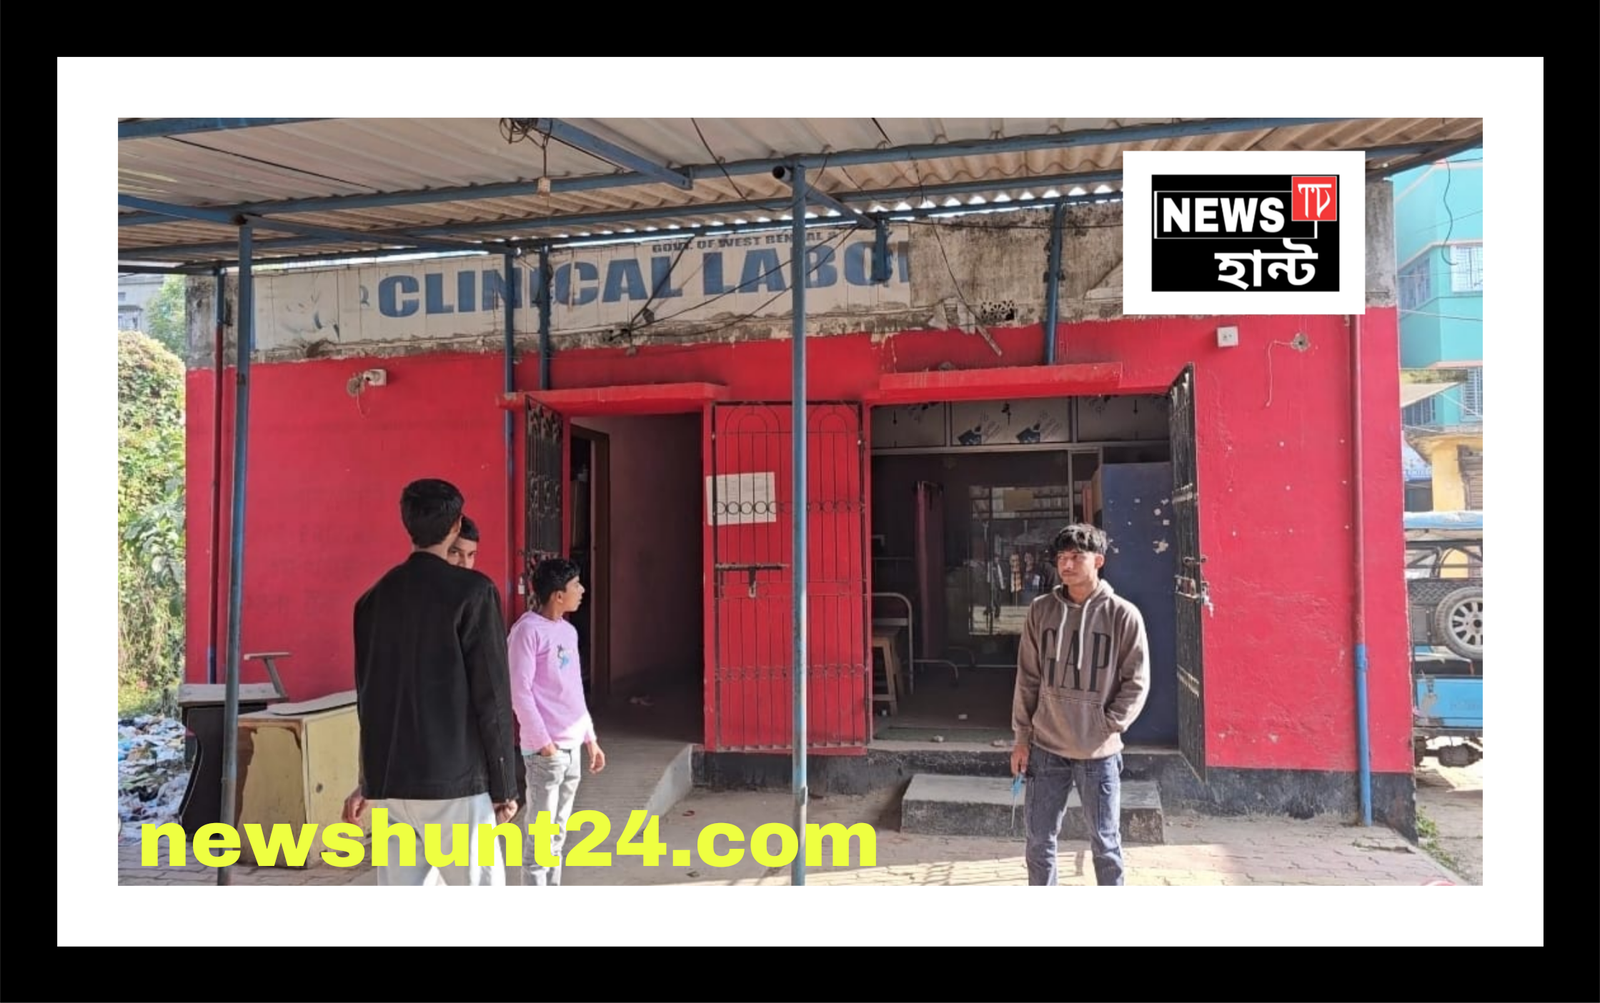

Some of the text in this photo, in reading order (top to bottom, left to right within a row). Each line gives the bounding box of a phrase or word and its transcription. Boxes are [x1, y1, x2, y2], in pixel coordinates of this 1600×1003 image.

[697, 239, 715, 250] OF
[718, 236, 761, 248] WEST
[765, 231, 823, 244] BENAL
[1041, 627, 1112, 693] GAP
